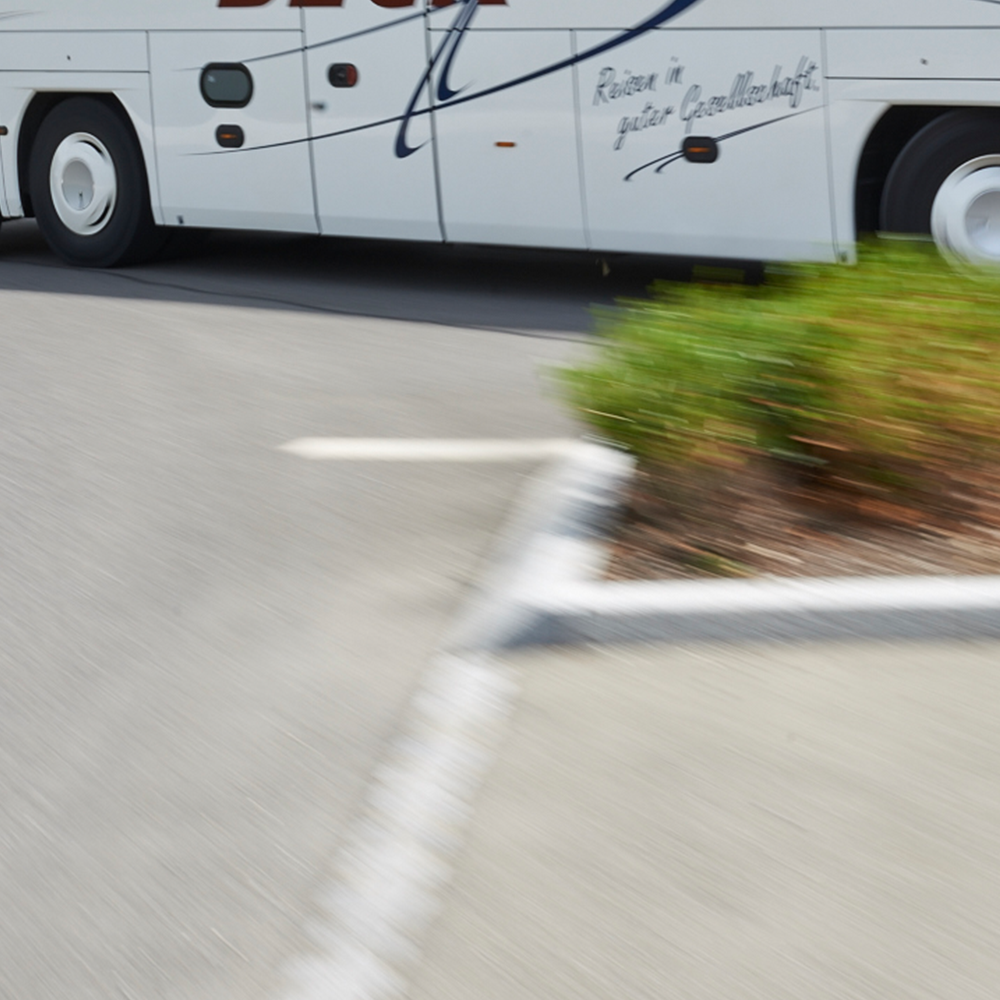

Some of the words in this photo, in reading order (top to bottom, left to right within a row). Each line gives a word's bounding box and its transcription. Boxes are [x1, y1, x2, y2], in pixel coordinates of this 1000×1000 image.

[593, 66, 658, 107] Reisen
[665, 56, 685, 85] in
[613, 102, 675, 151] guter
